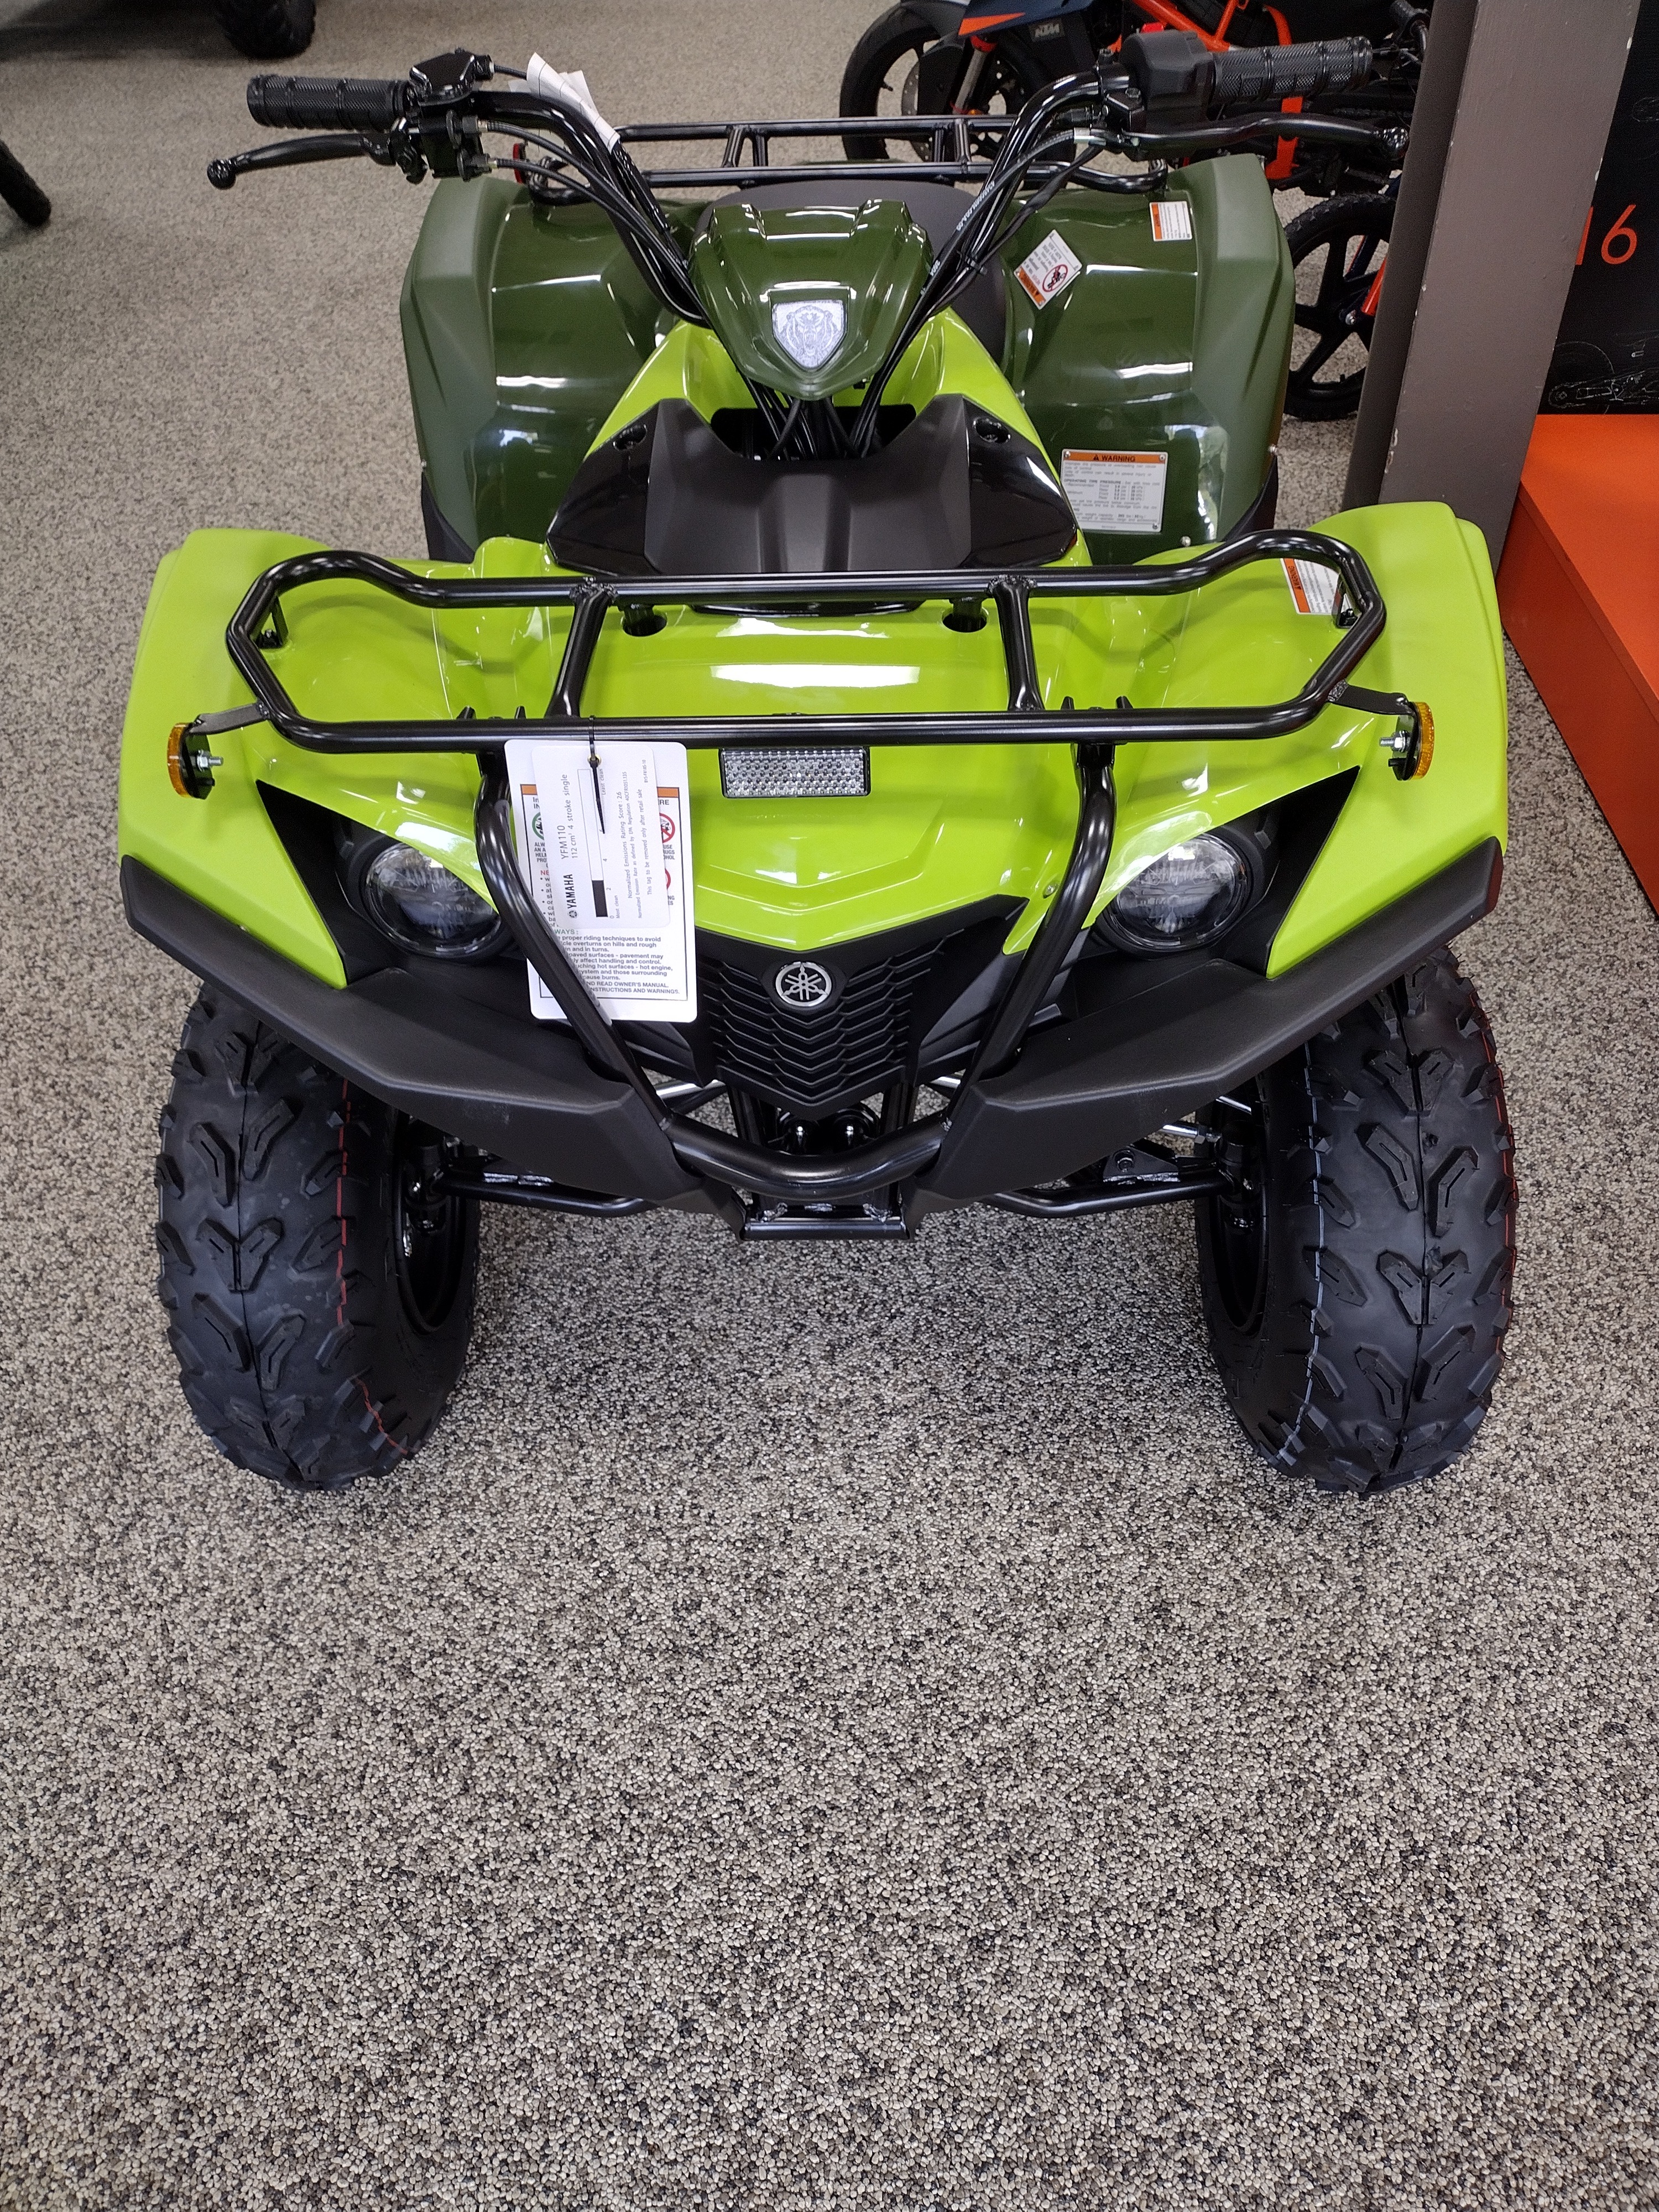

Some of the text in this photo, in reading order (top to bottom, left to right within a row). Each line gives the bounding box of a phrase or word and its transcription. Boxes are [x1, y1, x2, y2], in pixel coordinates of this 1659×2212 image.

[1035, 24, 1060, 38] KTM
[1101, 454, 1136, 463] WARNING
[561, 774, 570, 796] single
[564, 800, 573, 821] stroke
[557, 825, 569, 859] YFM110
[563, 874, 577, 909] YAMAHA
[624, 869, 633, 899] Normalized
